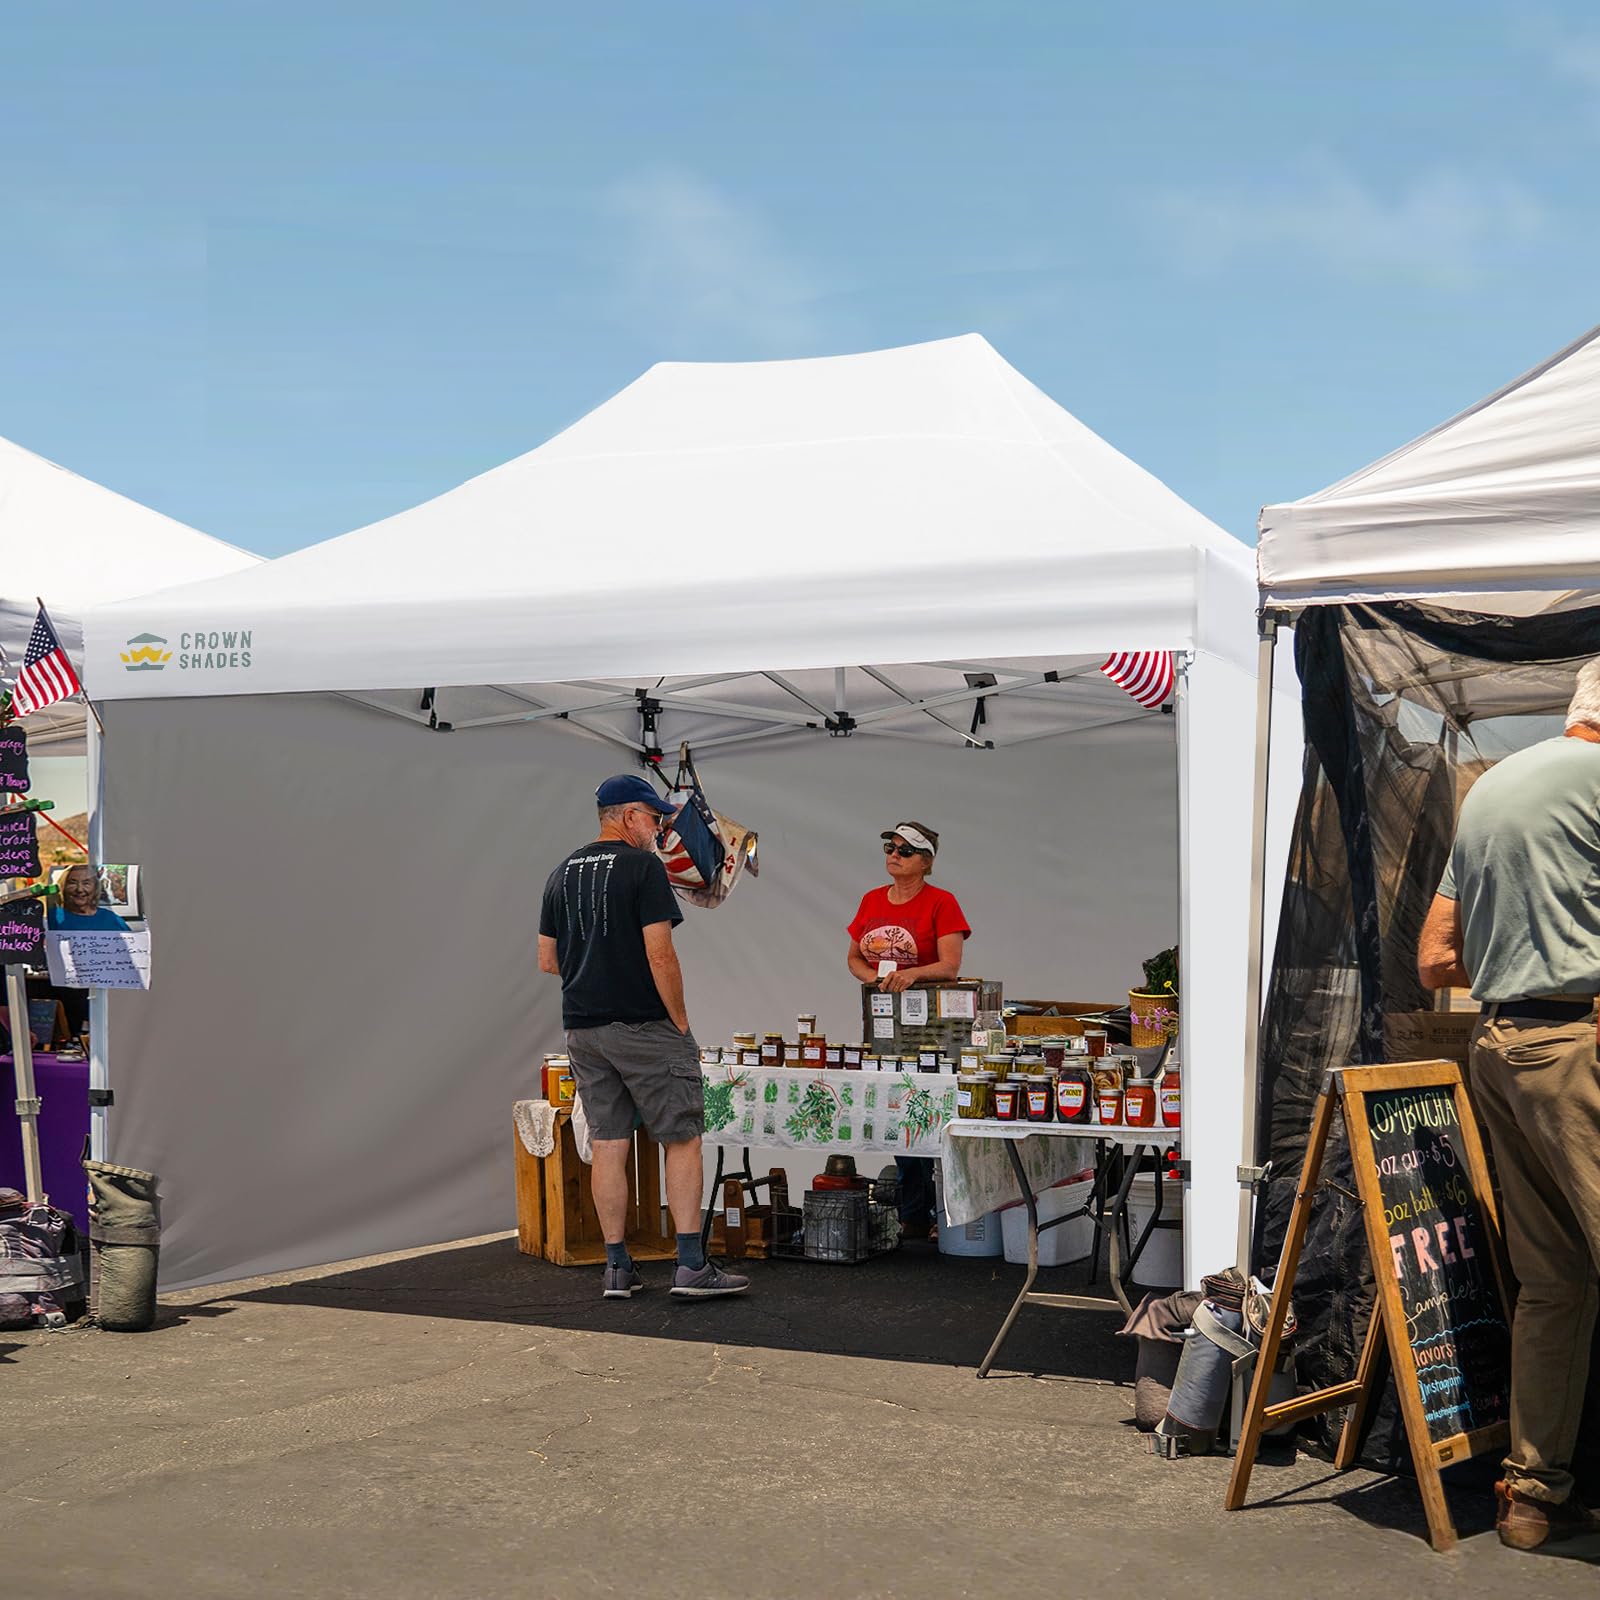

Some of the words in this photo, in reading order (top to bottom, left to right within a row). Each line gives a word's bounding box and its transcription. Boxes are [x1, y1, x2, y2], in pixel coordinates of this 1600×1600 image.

[180, 630, 252, 650] CROWN
[179, 651, 251, 669] SHADES
[0, 833, 35, 846] orant
[1431, 1134, 1455, 1167] $5
[1445, 1174, 1468, 1206] $6
[1388, 1216, 1475, 1280] FREE
[1411, 1343, 1458, 1367] lavors:
